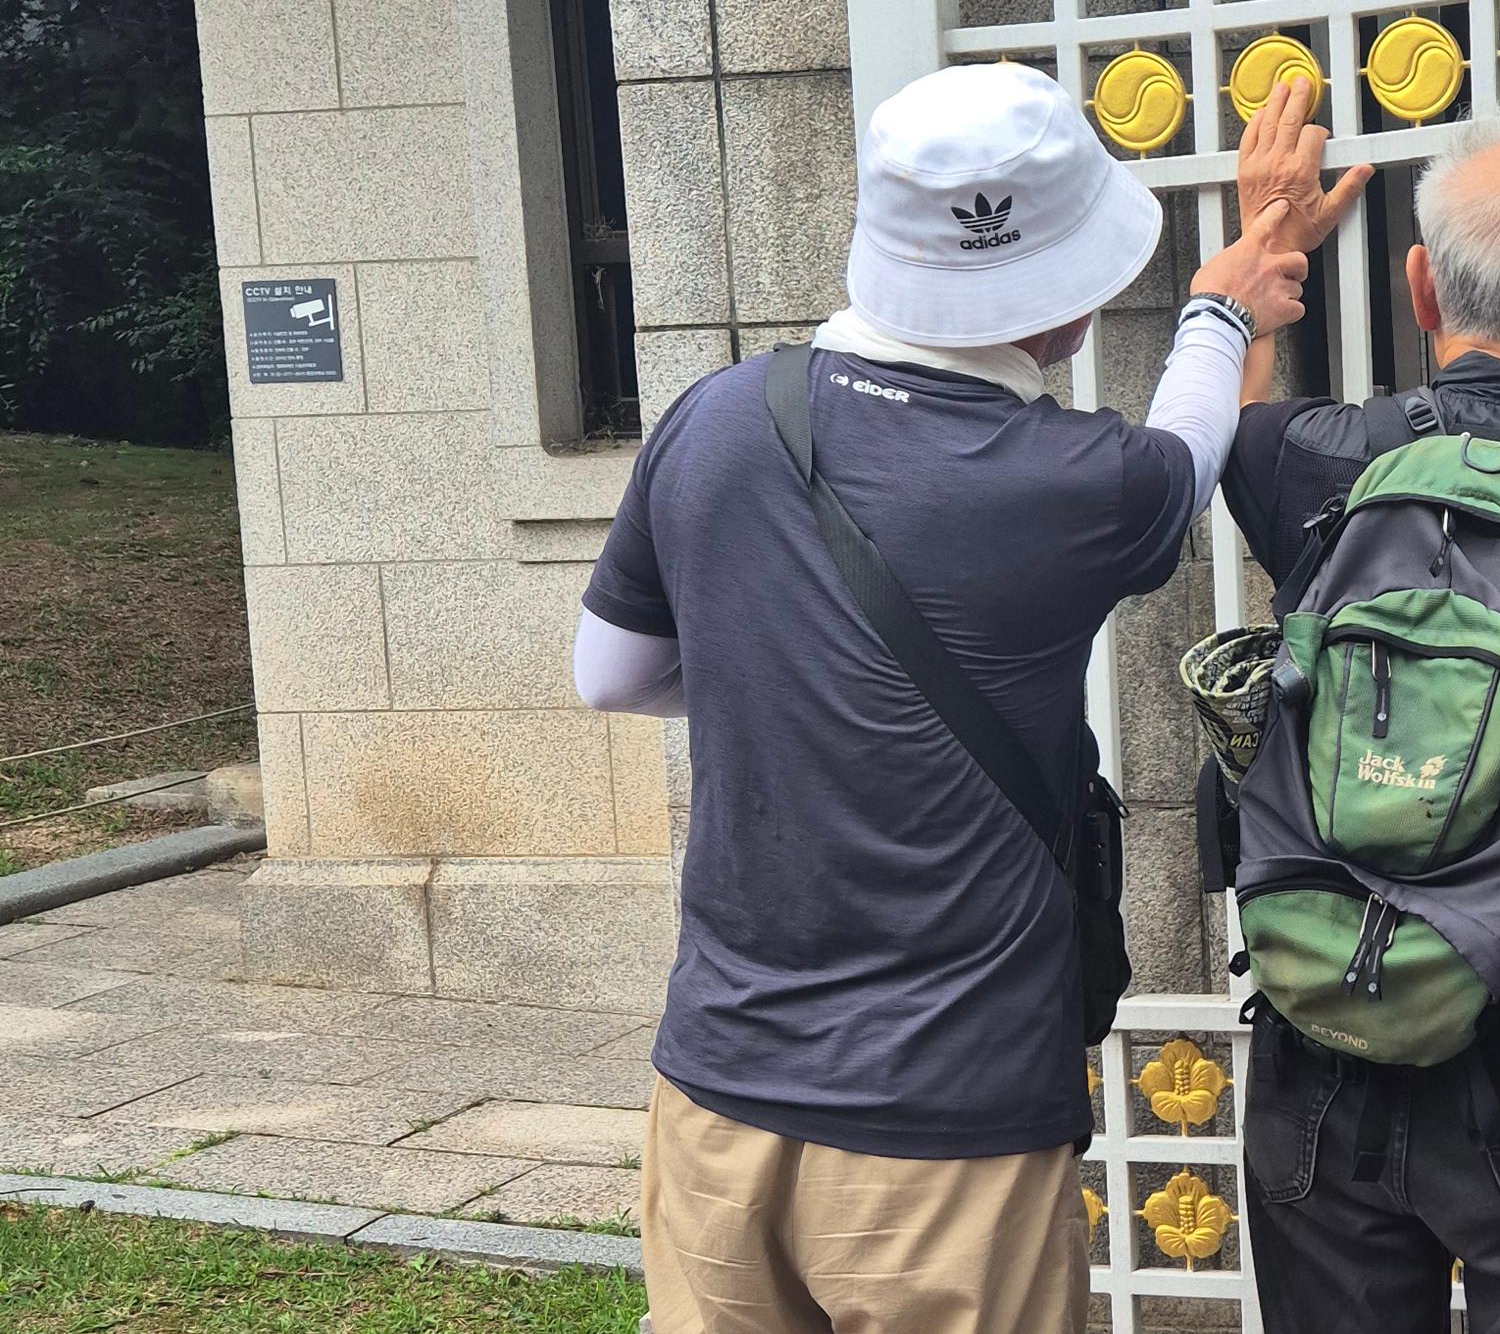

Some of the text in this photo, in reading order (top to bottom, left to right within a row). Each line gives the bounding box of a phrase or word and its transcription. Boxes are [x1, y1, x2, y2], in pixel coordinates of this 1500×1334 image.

[960, 229, 1021, 250] adidas
[245, 287, 270, 296] CCTV
[295, 285, 312, 294] 안내
[1359, 749, 1406, 772] Jack
[1357, 763, 1437, 789] Wolfskin
[1311, 1024, 1368, 1050] BEYOND
